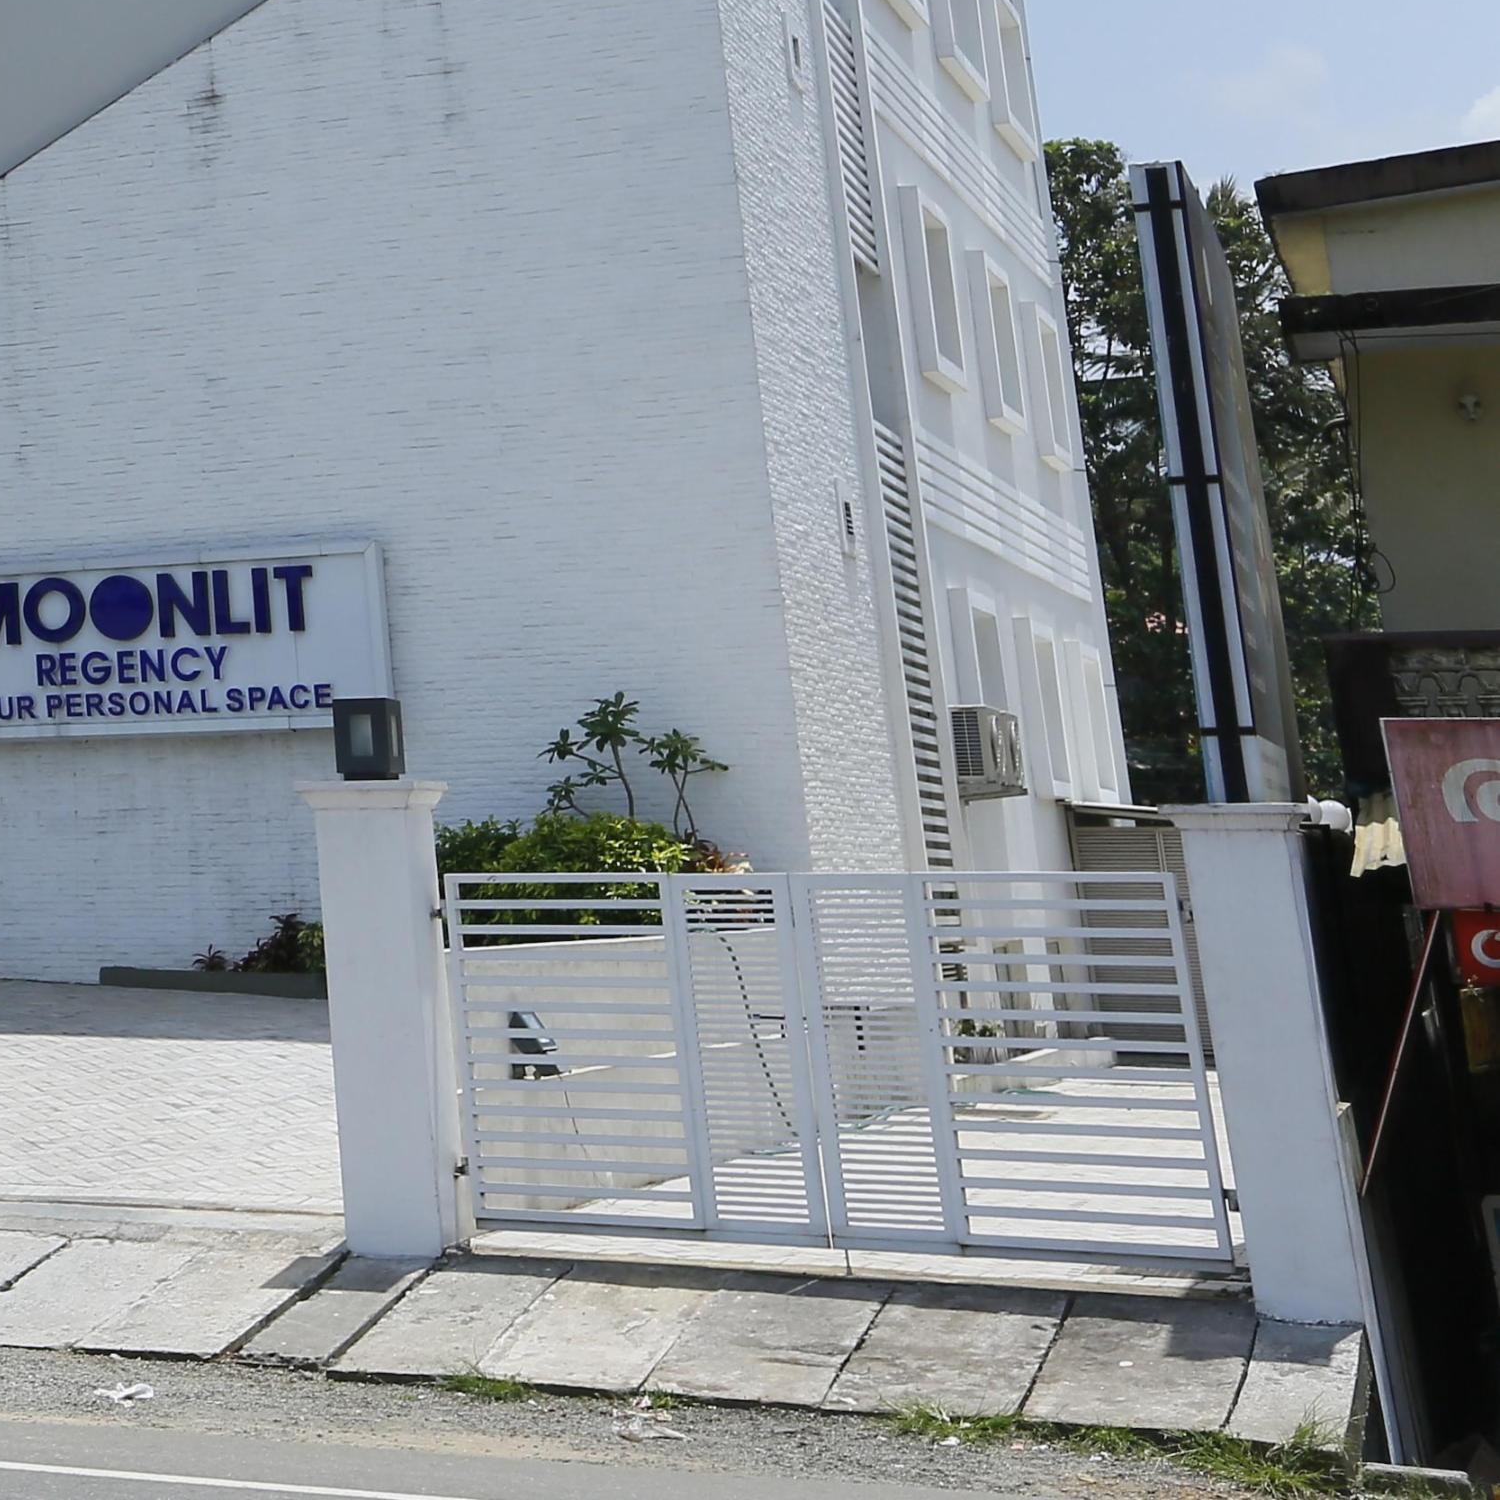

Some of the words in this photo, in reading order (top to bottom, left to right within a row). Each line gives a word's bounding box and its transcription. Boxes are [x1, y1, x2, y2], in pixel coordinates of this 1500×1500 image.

[35, 646, 228, 687] REGENCY
[46, 688, 218, 718] PERSONAL
[225, 683, 333, 712] SPACE
